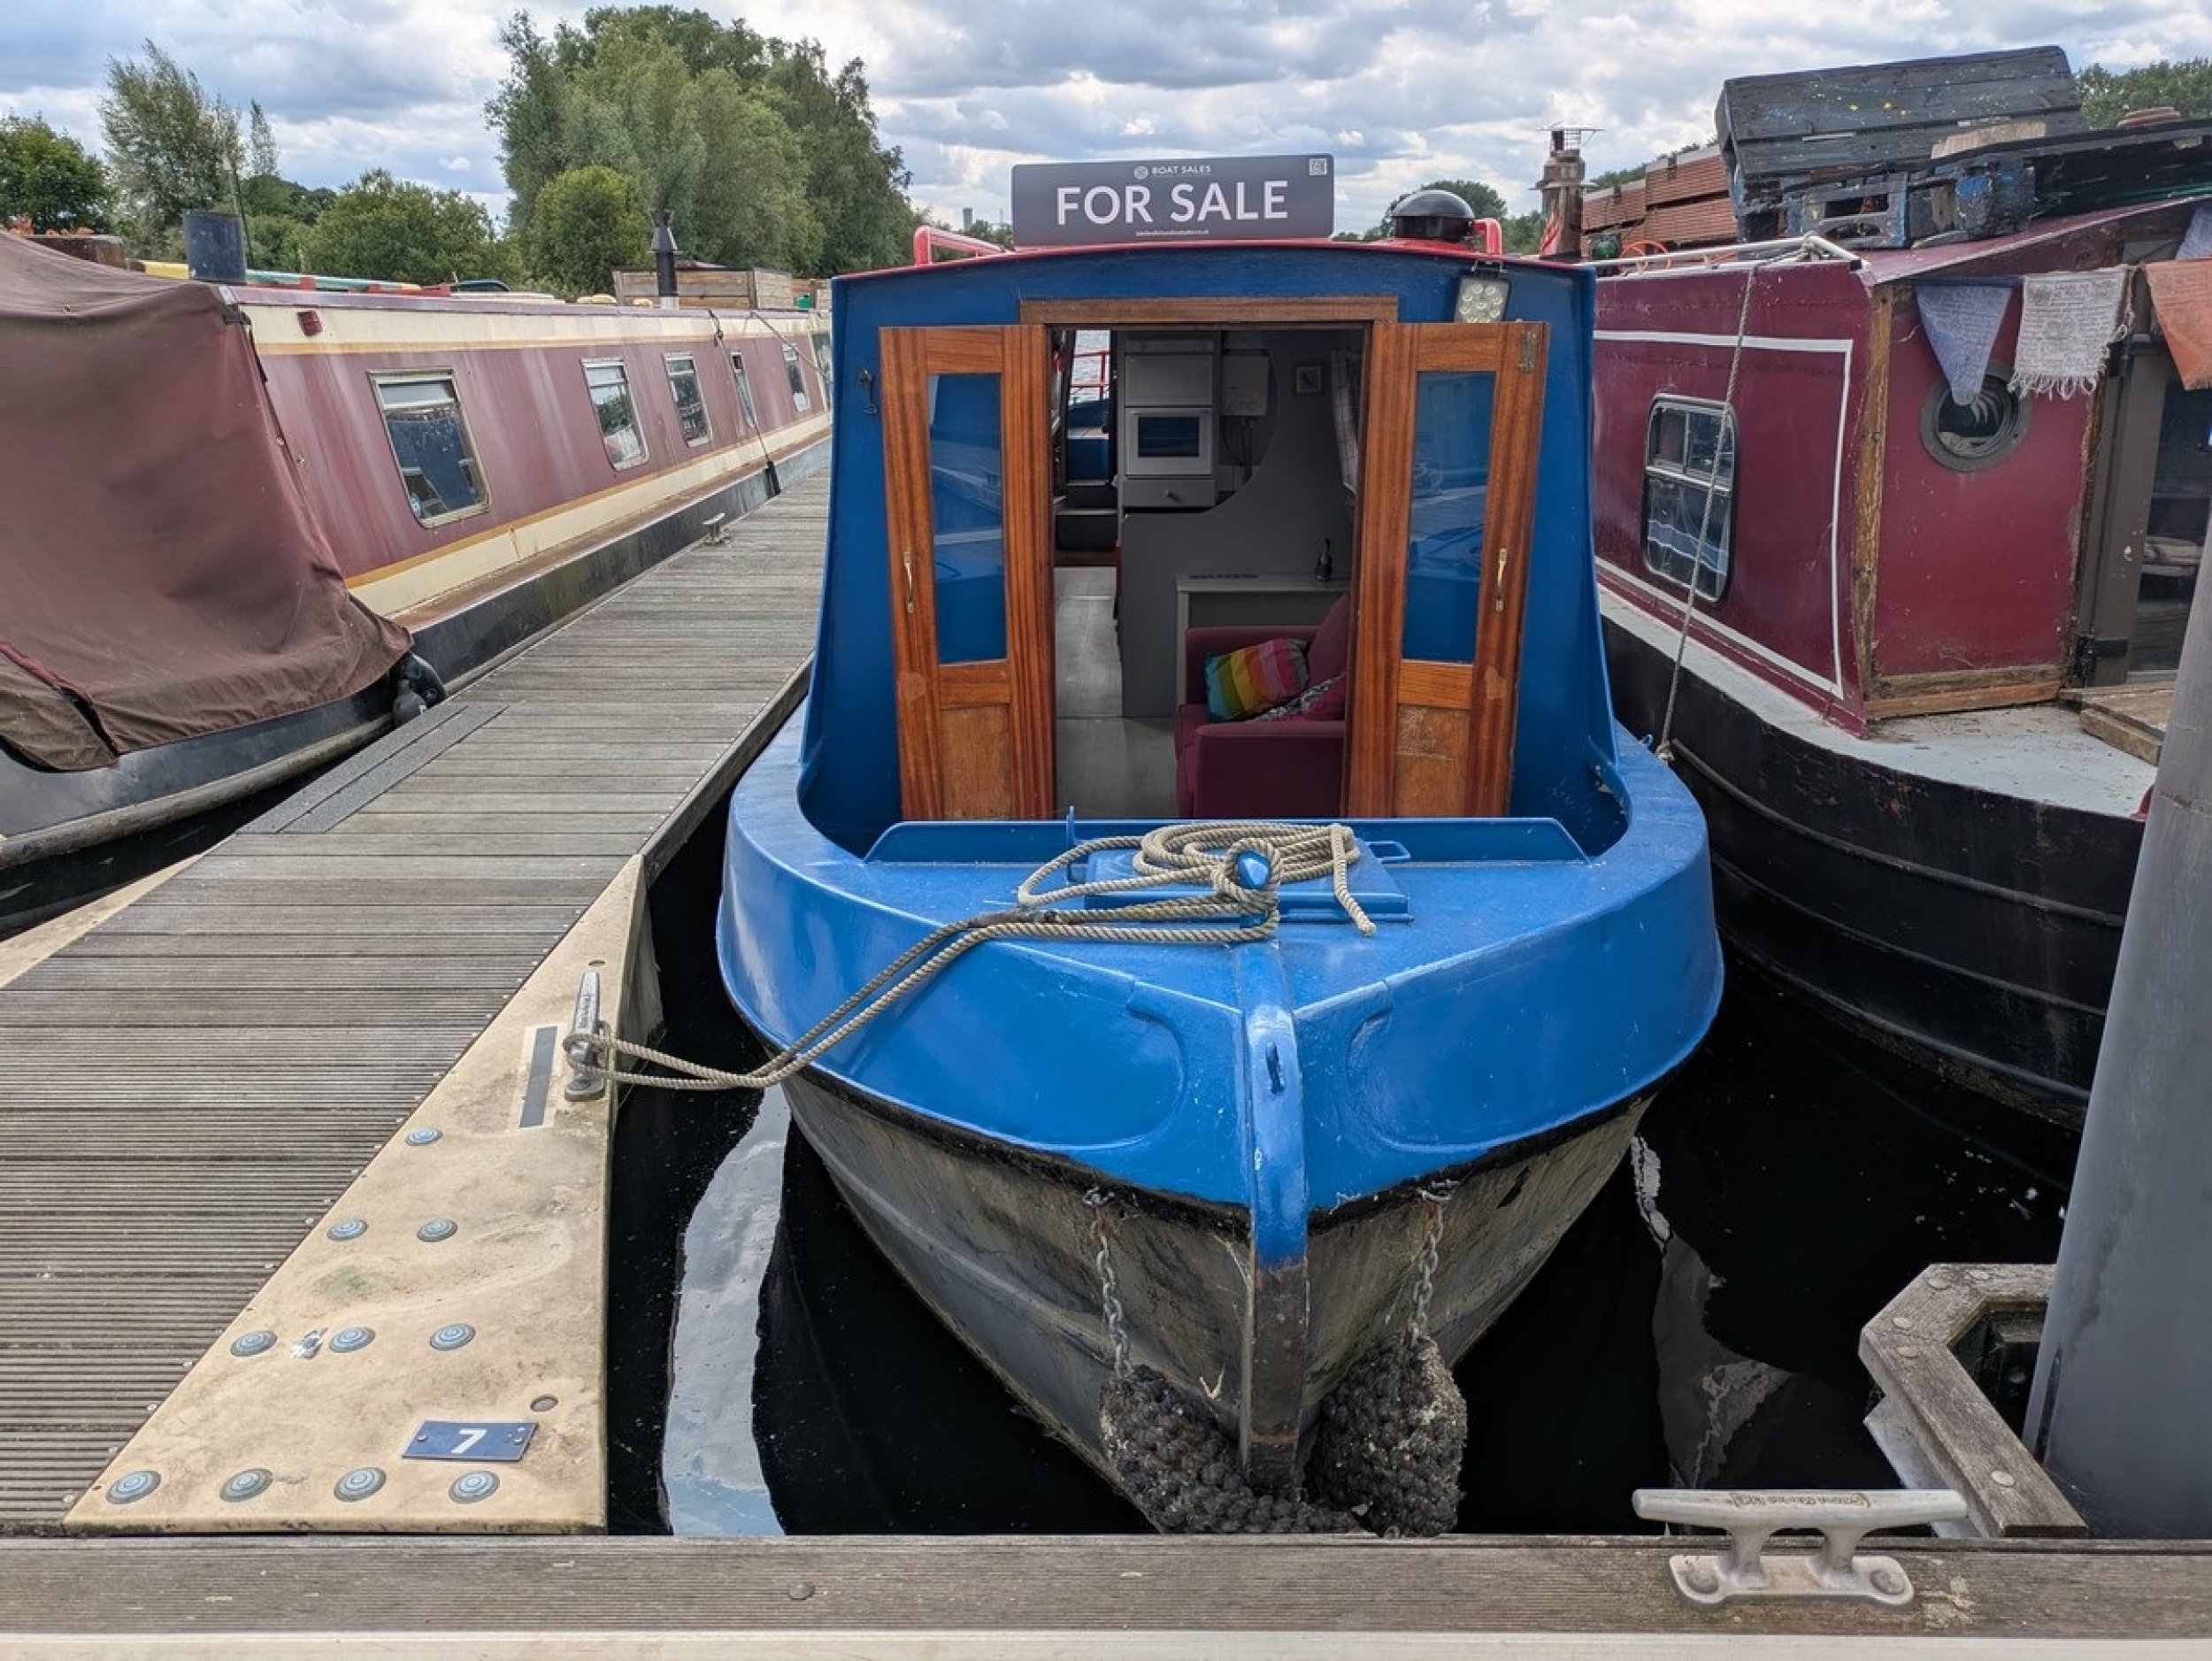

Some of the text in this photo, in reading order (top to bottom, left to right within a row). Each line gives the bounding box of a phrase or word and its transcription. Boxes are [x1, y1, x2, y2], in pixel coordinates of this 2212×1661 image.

[1152, 164, 1211, 174] BOAT SALES
[1057, 181, 1288, 225] FOR SALE
[451, 1428, 488, 1453] 7
